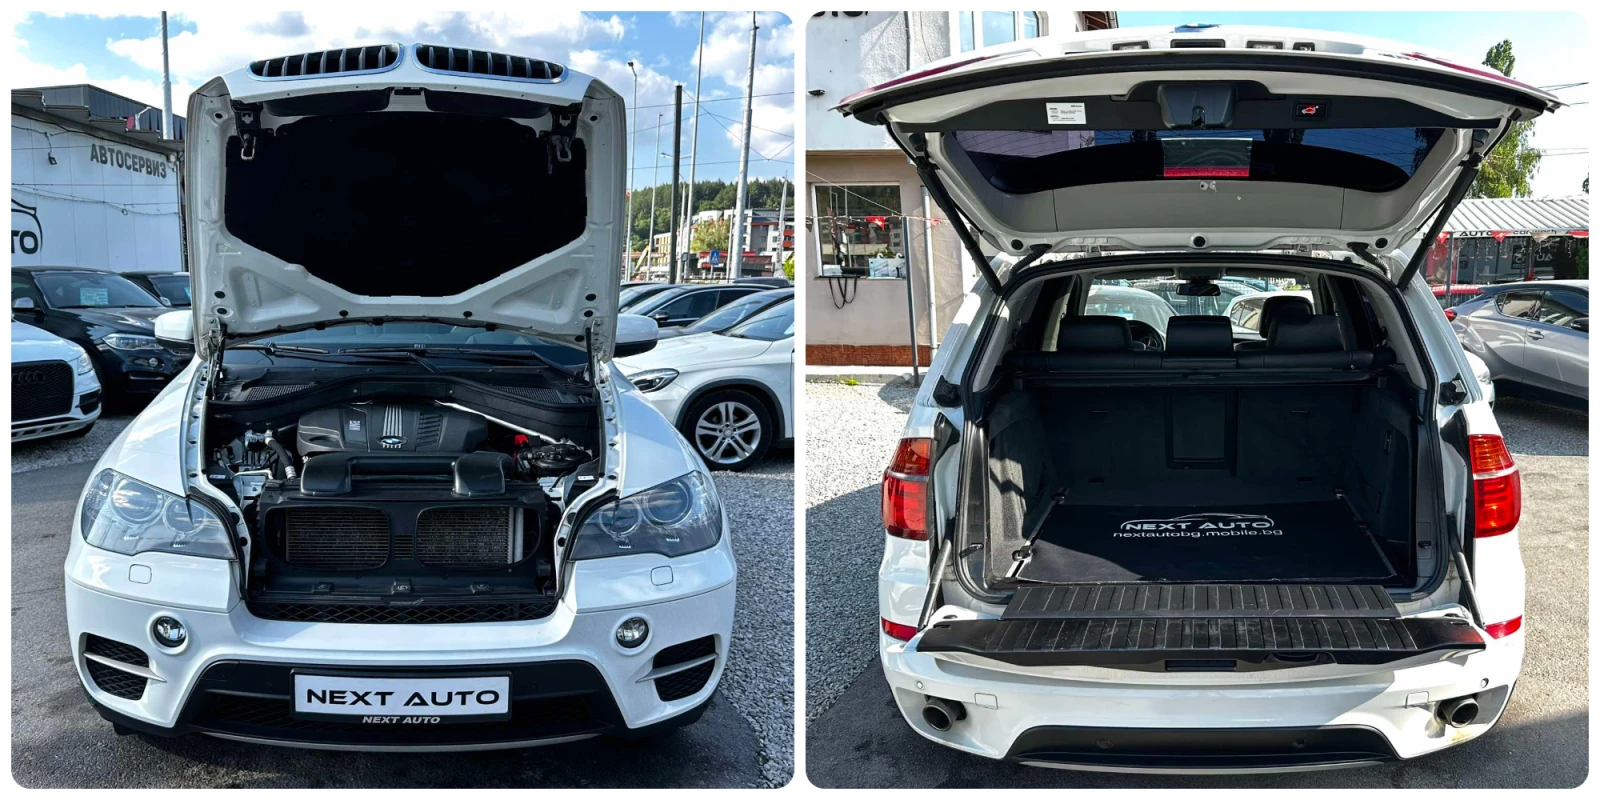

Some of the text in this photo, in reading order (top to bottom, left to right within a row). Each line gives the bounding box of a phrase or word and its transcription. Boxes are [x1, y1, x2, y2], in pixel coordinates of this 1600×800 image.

[90, 143, 167, 179] АВТОСЕРВИЗ
[1124, 521, 1271, 531] NEXT AUTO
[1113, 529, 1283, 538] nextautobg.mobile.bg
[306, 688, 500, 707] NEXT AUTO
[362, 716, 441, 724] NEXT AUTO
